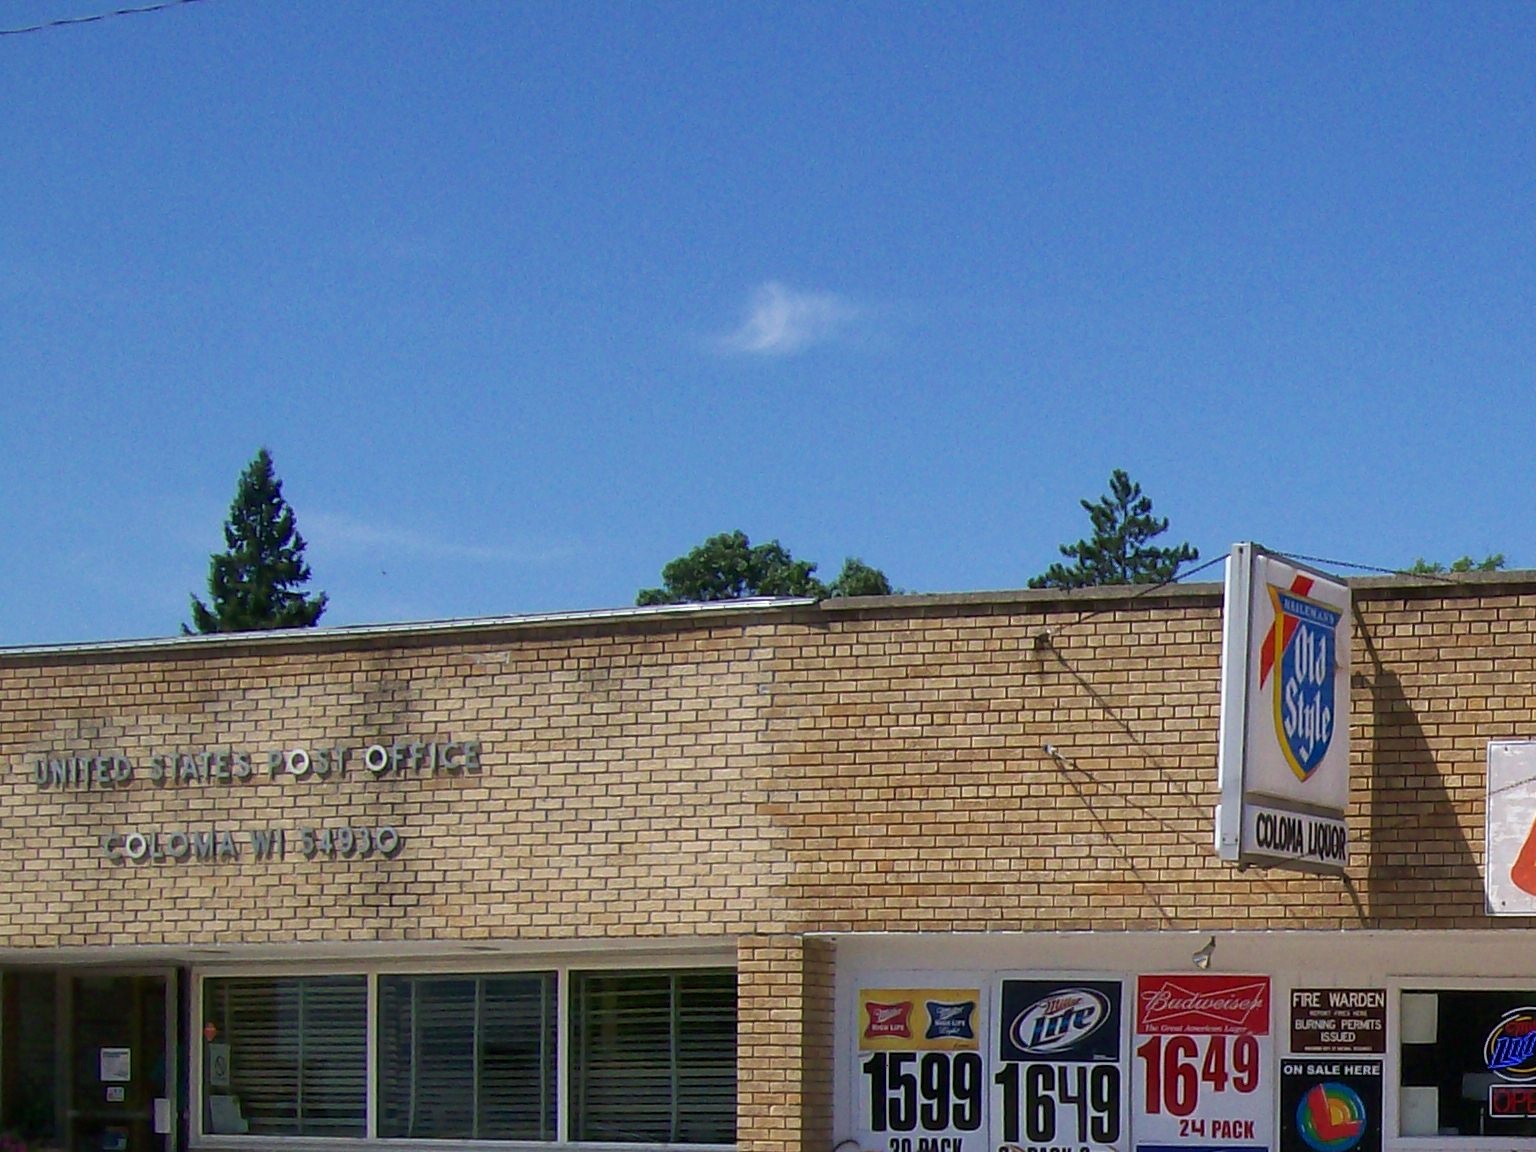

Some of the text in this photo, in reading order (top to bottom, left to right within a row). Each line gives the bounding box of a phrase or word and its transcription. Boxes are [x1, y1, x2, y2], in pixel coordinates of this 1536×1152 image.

[1294, 624, 1327, 686] Old
[1284, 677, 1331, 763] Style
[34, 742, 481, 787] UNITED STATES POST OFFICE
[103, 826, 401, 860] COLOMA WI 54930
[1256, 813, 1346, 860] COLOMA LIQUOR
[1140, 990, 1263, 1011] Budweiser
[1293, 992, 1385, 1008] FIRE WARDEN
[872, 1024, 905, 1032] HIGH LIFE
[1029, 1006, 1096, 1047] Lite
[1145, 1024, 1159, 1032] The
[1184, 1024, 1222, 1032] American
[1295, 1019, 1382, 1030] BURNING PERMITS
[1321, 1032, 1356, 1043] ISSUED
[1137, 1035, 1259, 1117] 1649
[1283, 1065, 1380, 1076] ON SALE HERE
[863, 1052, 983, 1133] 1599
[995, 1063, 1121, 1144] 1649
[1180, 1119, 1255, 1139] 24 PACK
